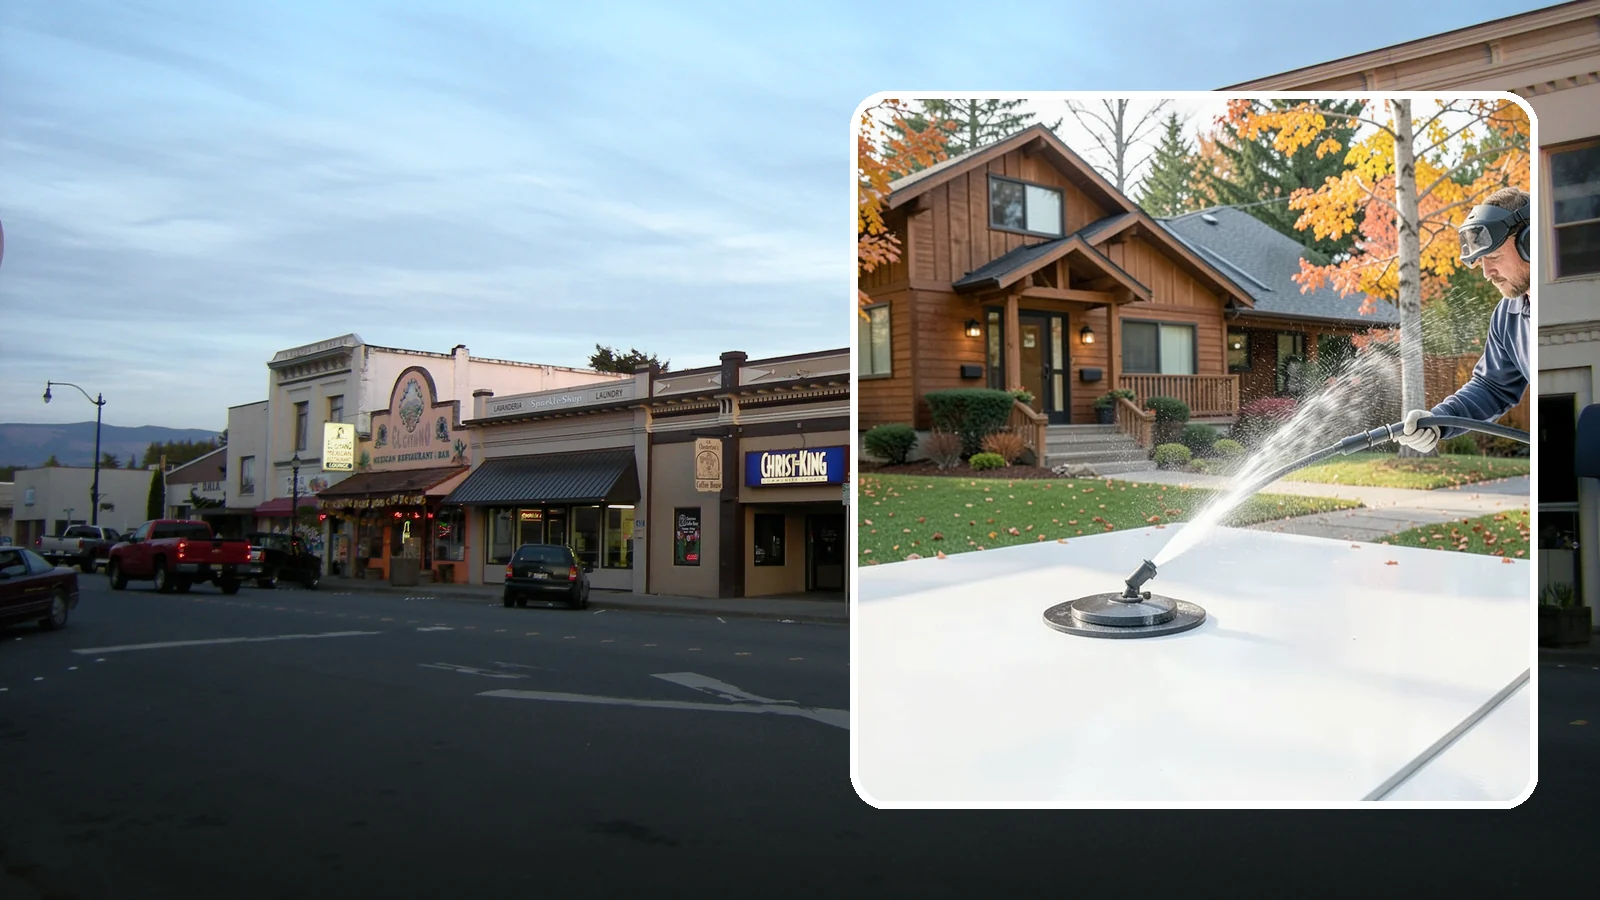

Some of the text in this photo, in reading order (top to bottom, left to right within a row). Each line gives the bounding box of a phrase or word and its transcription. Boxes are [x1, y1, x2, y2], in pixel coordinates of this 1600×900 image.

[493, 402, 522, 412] LAVANDERIA
[562, 394, 582, 405] Shop
[596, 389, 623, 400] LAUNDRY
[374, 454, 396, 464] MEXICAN
[397, 451, 434, 463] RESTAURANT
[438, 450, 450, 459] BAR
[799, 450, 827, 476] KING
